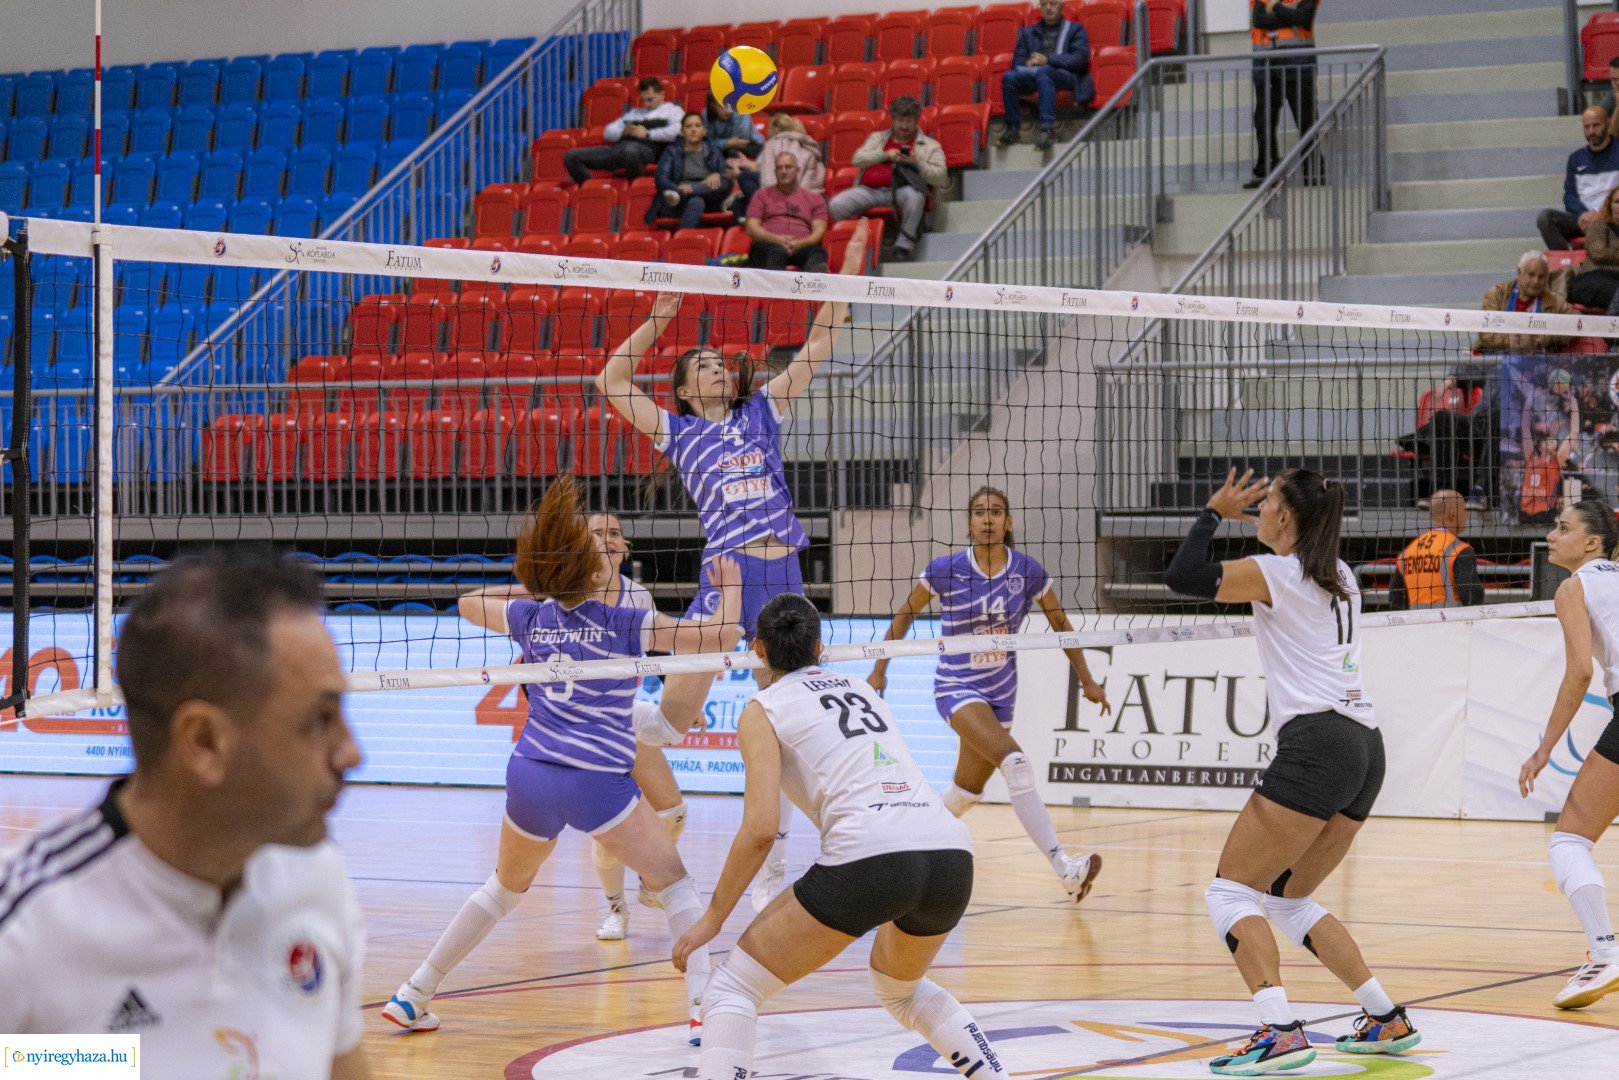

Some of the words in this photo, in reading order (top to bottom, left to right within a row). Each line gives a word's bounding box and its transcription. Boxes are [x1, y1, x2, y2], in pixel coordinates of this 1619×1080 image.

[385, 250, 422, 268] FATUM
[640, 266, 673, 284] FATUM
[867, 281, 895, 297] FATUM
[1060, 292, 1087, 308] FATUM
[980, 596, 1006, 621] 14
[1330, 595, 1353, 645] 11
[530, 627, 603, 644] GOODWIN
[635, 661, 662, 674] FATUM
[379, 674, 410, 688] FATUM
[819, 692, 888, 739] 23
[86, 746, 106, 757] 4400
[964, 1022, 1004, 1073] ninesquared
